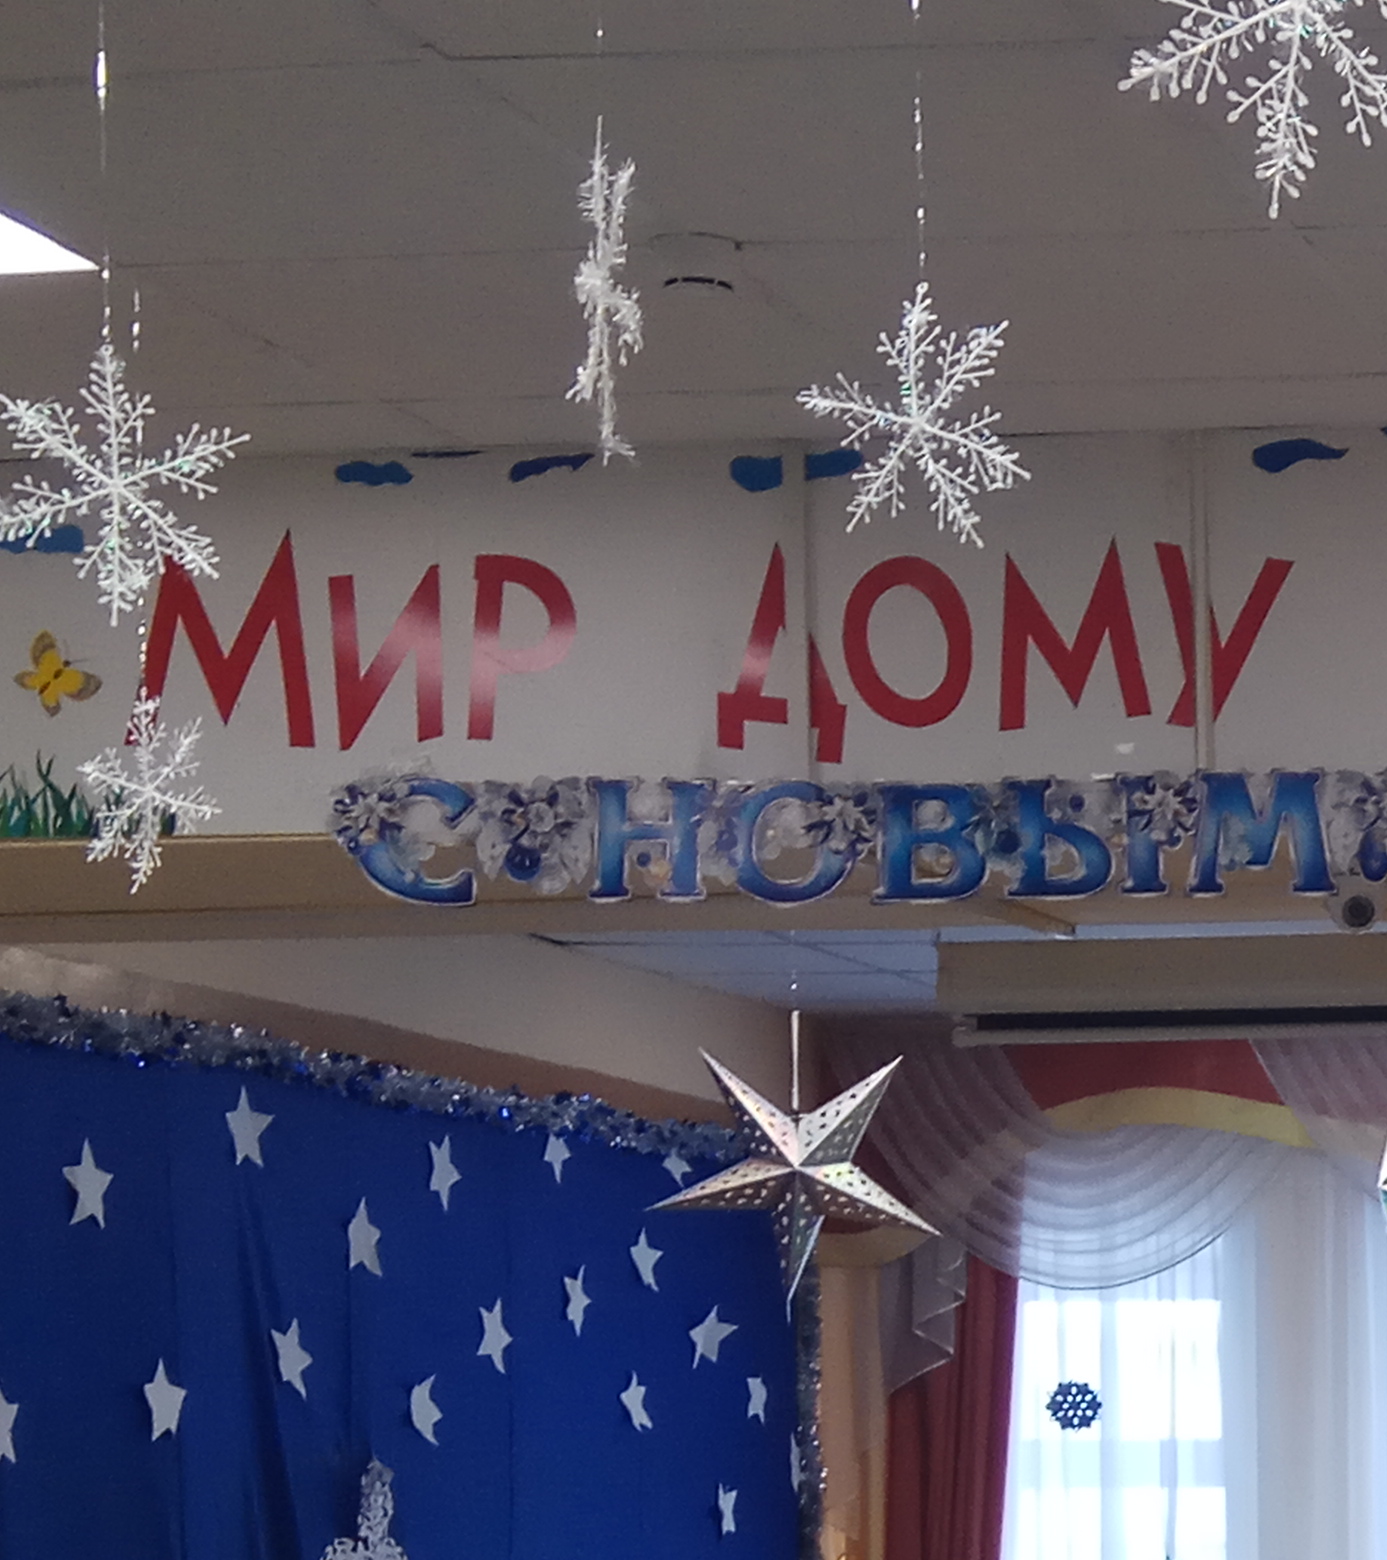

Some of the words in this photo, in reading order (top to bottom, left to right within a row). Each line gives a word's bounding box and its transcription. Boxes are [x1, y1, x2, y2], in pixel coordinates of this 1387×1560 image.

[124, 529, 577, 750] МИР
[716, 535, 1294, 763] ДОМУ
[346, 777, 477, 907] С
[586, 768, 1338, 906] НОВЫМ
